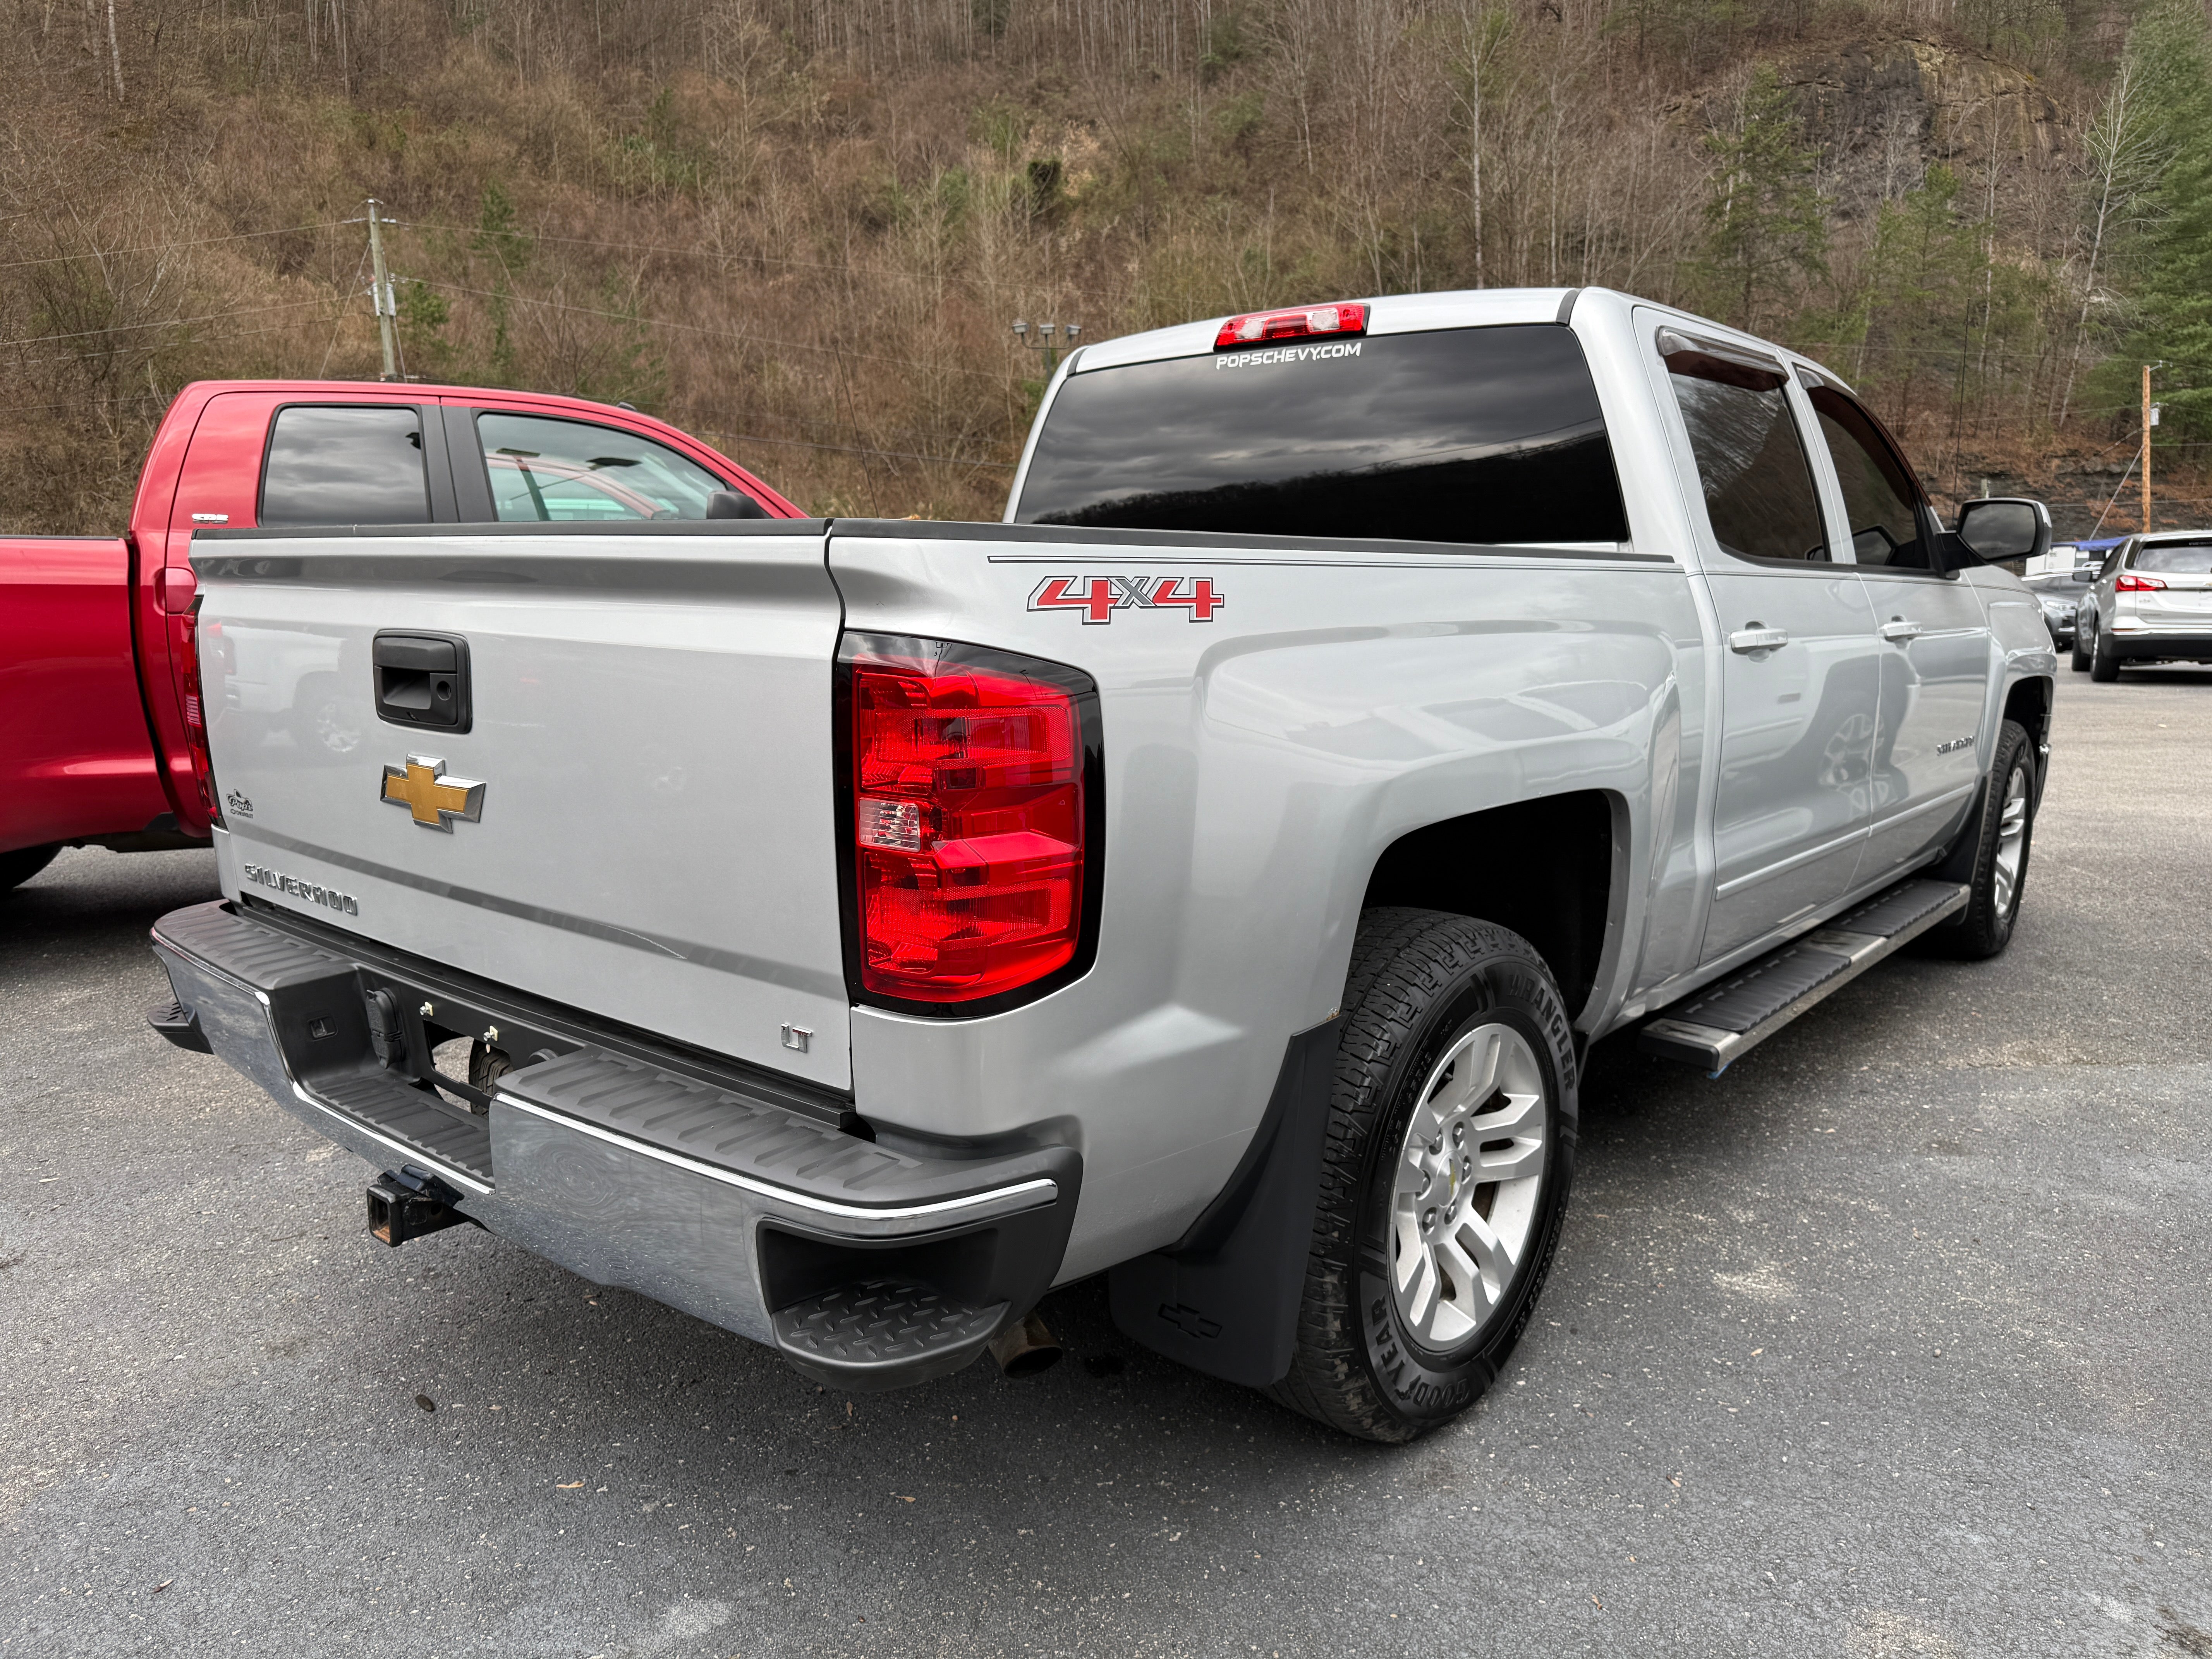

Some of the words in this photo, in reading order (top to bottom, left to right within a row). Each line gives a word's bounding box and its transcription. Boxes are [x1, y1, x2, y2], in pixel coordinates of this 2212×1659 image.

[1216, 342, 1362, 370] POPSCHEVY.COM
[245, 863, 358, 916] SILVERADO
[781, 1023, 813, 1053] LT
[1506, 974, 1575, 1092] WRANGLER
